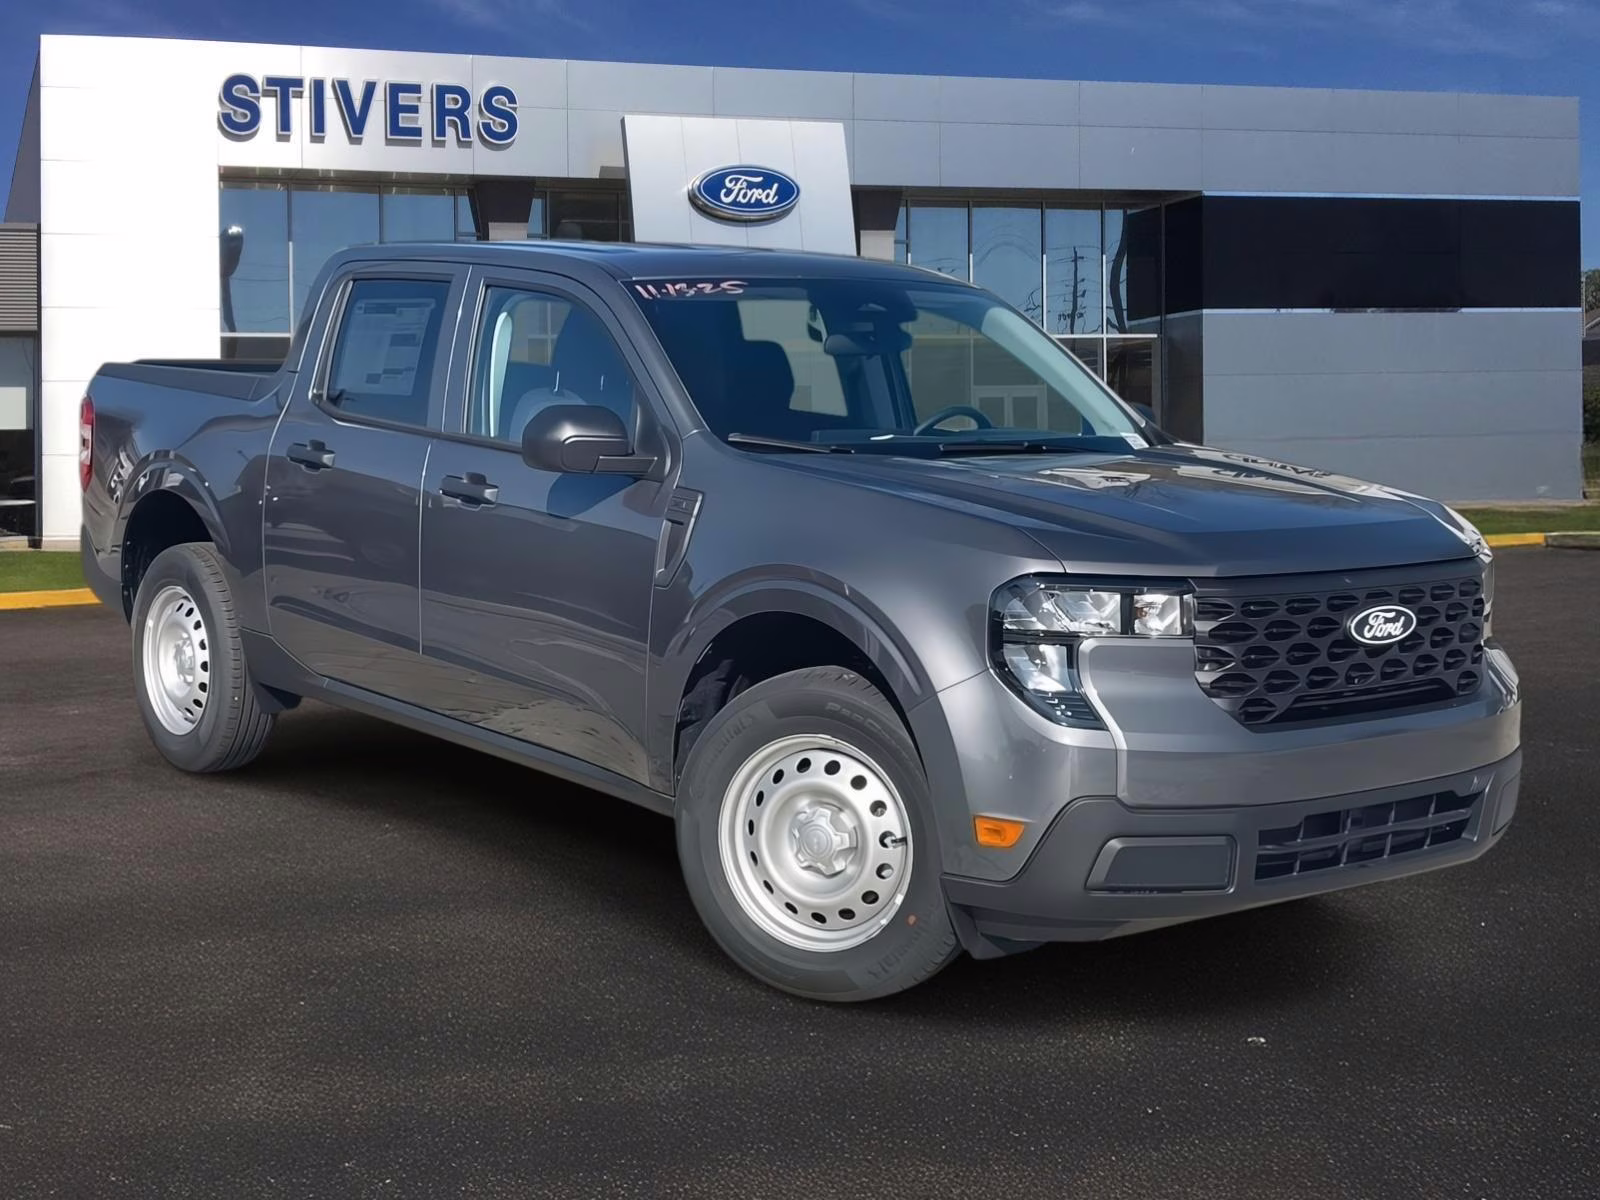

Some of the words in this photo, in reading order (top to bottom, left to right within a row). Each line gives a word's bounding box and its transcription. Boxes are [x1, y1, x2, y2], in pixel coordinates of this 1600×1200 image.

[218, 73, 519, 148] STIVERS
[720, 174, 779, 204] Ford
[1363, 611, 1405, 638] Ford
